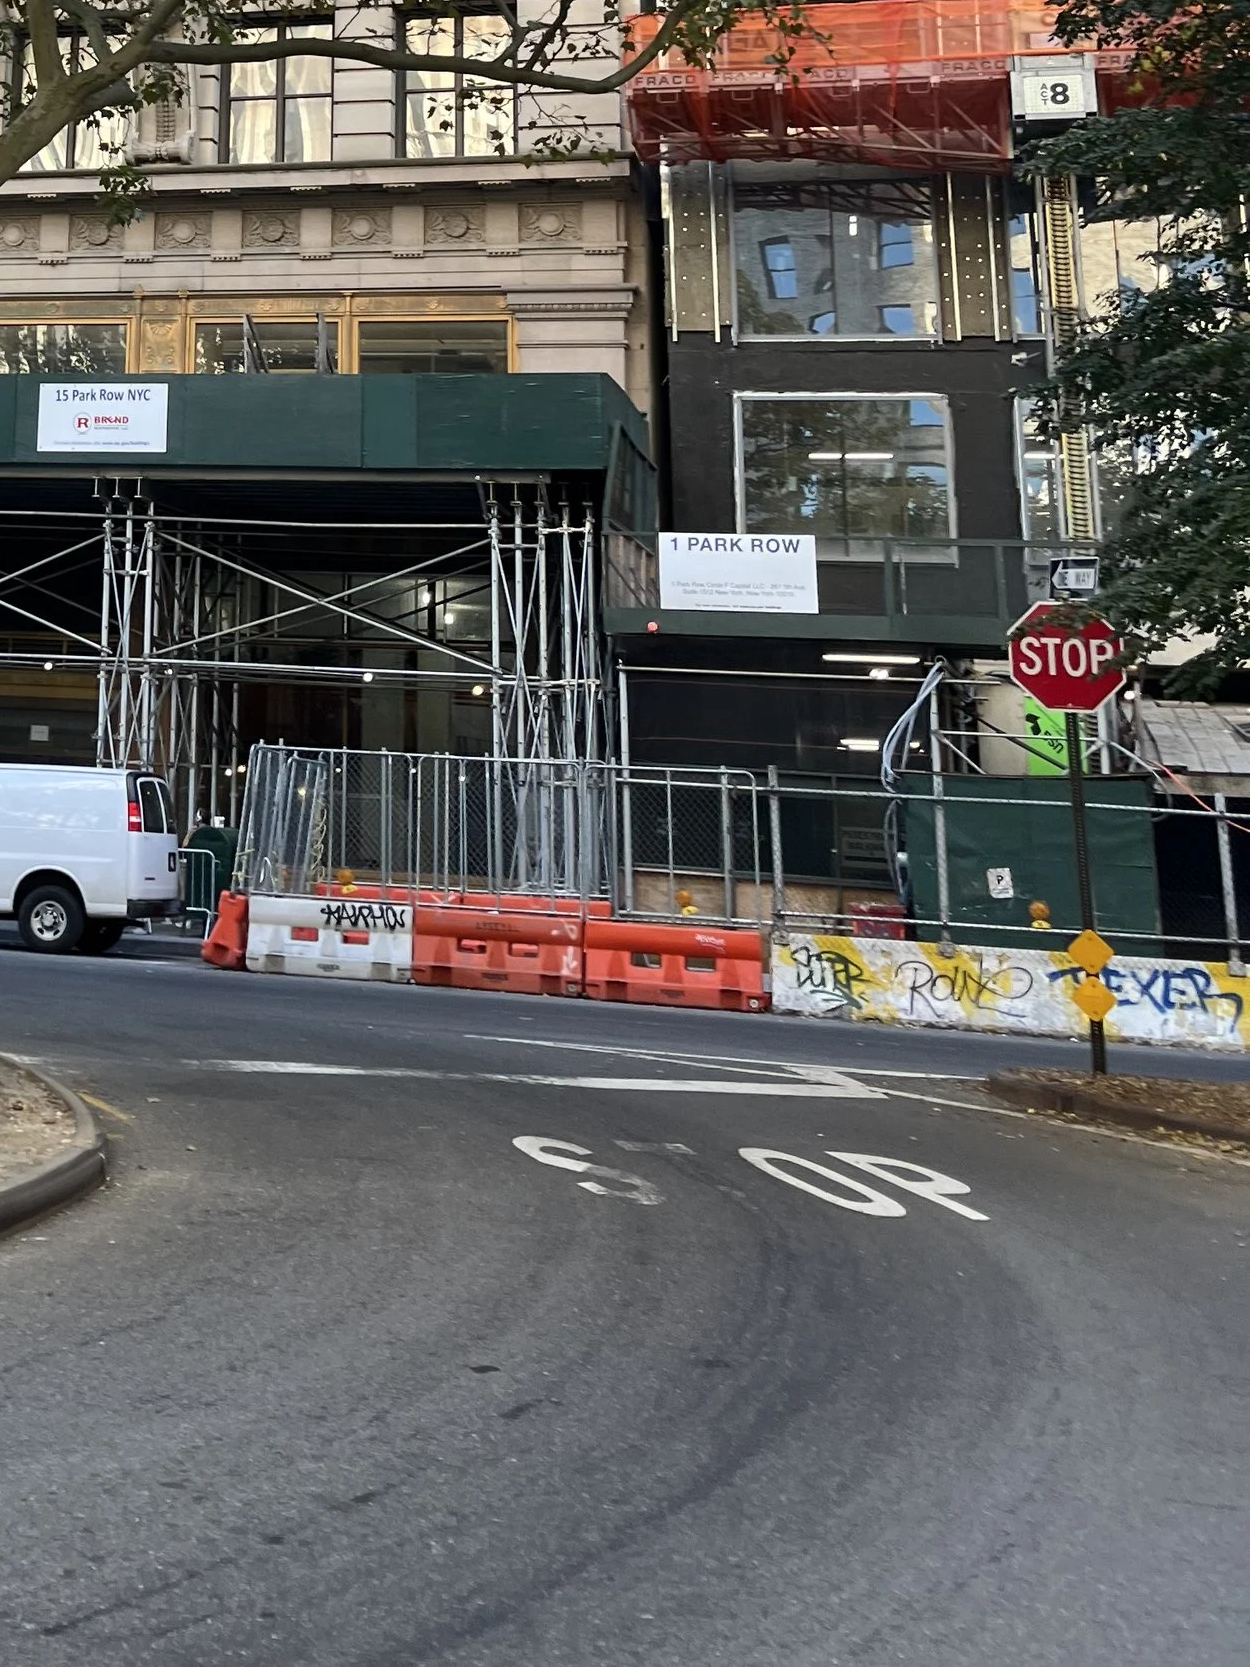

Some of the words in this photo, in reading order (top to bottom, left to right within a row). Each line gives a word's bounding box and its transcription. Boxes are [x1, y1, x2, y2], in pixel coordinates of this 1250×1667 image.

[1050, 82, 1070, 105] 8
[55, 389, 69, 401] 15
[72, 388, 97, 401] Park
[99, 389, 124, 401] Row
[127, 388, 151, 401] NYC
[670, 537, 678, 551] 1
[688, 537, 743, 552] PARK
[751, 538, 800, 553] ROW
[1019, 636, 1114, 677] STOP
